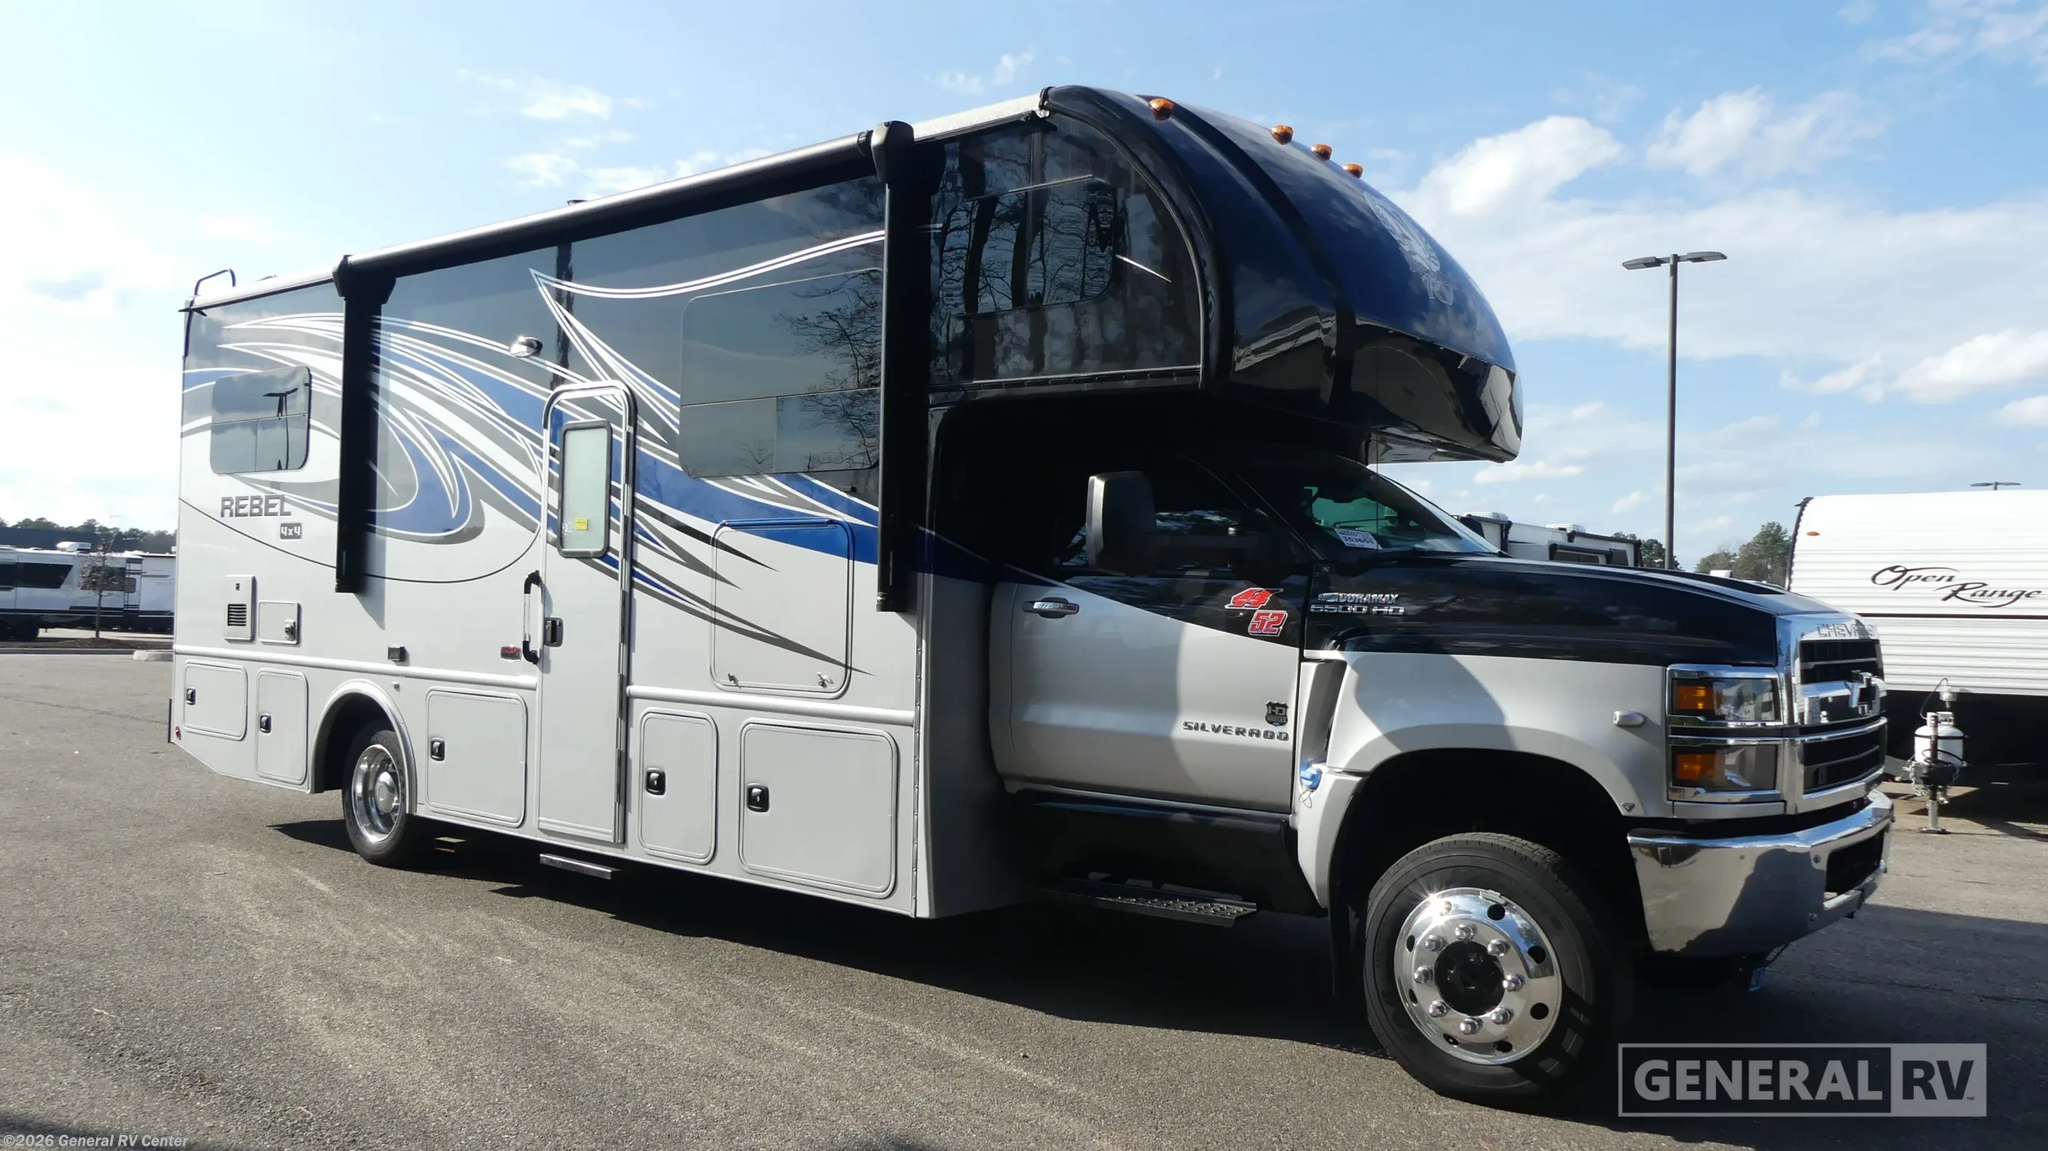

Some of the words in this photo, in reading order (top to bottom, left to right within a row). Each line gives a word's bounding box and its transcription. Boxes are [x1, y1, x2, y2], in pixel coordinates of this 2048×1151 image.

[221, 494, 292, 518] REBEL
[280, 526, 301, 537] 4x4
[1871, 565, 1960, 591] Open
[1934, 582, 2042, 608] Range
[1249, 611, 1287, 635] 52
[1372, 606, 1405, 616] HD
[1183, 721, 1290, 741] SILVERADO
